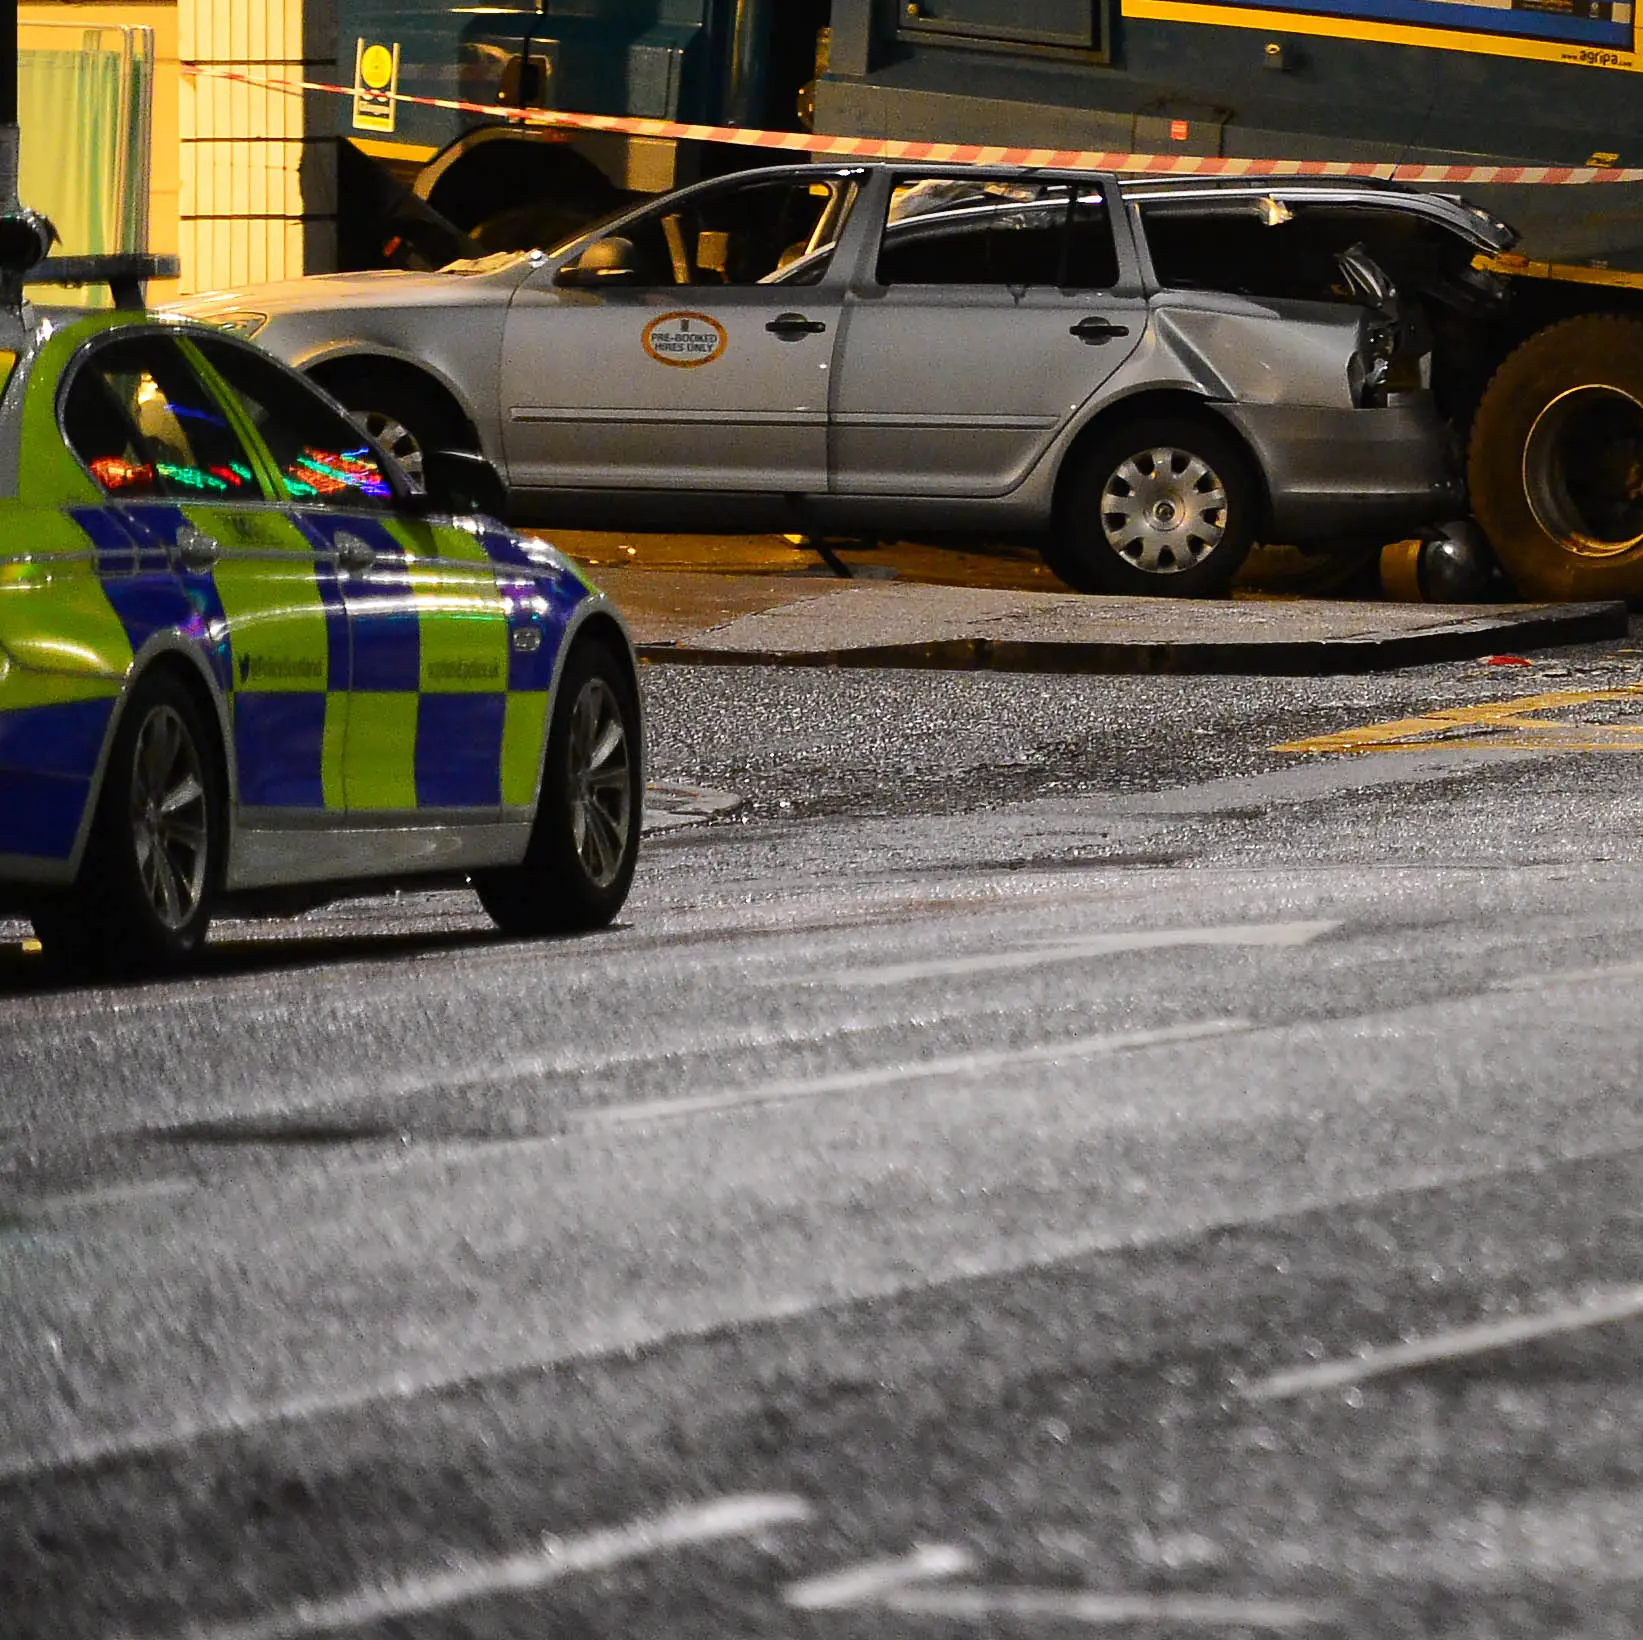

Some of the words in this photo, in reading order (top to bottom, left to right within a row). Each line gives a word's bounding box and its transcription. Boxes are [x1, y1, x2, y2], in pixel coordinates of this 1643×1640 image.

[651, 333, 717, 343] PRE-BOOKED
[655, 342, 685, 352] HIRES
[687, 343, 714, 353] ONLY
